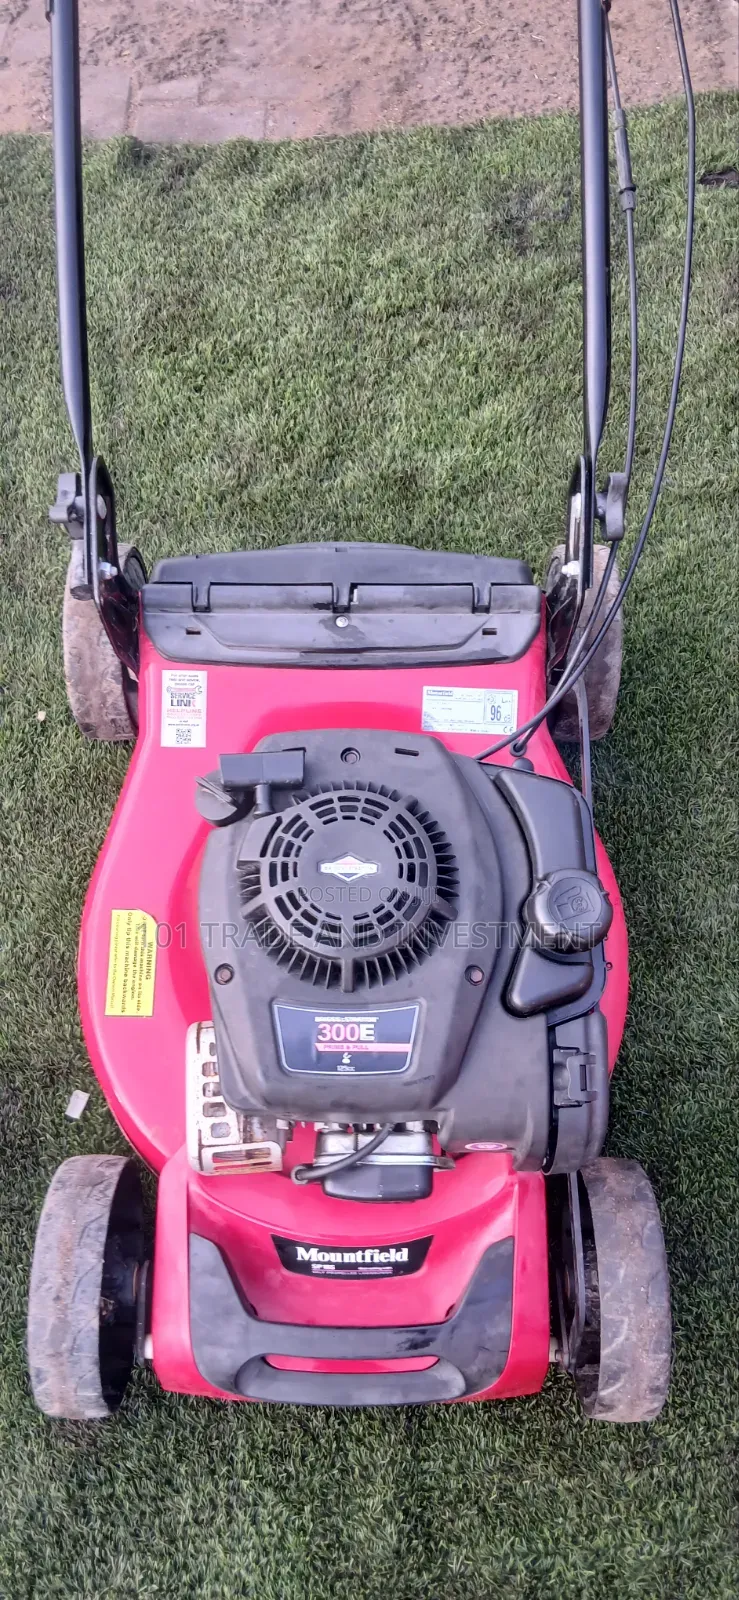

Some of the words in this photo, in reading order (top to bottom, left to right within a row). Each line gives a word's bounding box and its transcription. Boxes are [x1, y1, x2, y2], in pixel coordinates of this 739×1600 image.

[170, 692, 196, 700] SERVICE
[170, 699, 196, 707] LINK
[490, 704, 502, 721] 96
[146, 941, 154, 981] WARNING
[317, 1023, 375, 1041] 300E
[295, 1246, 409, 1263] Mountfield
